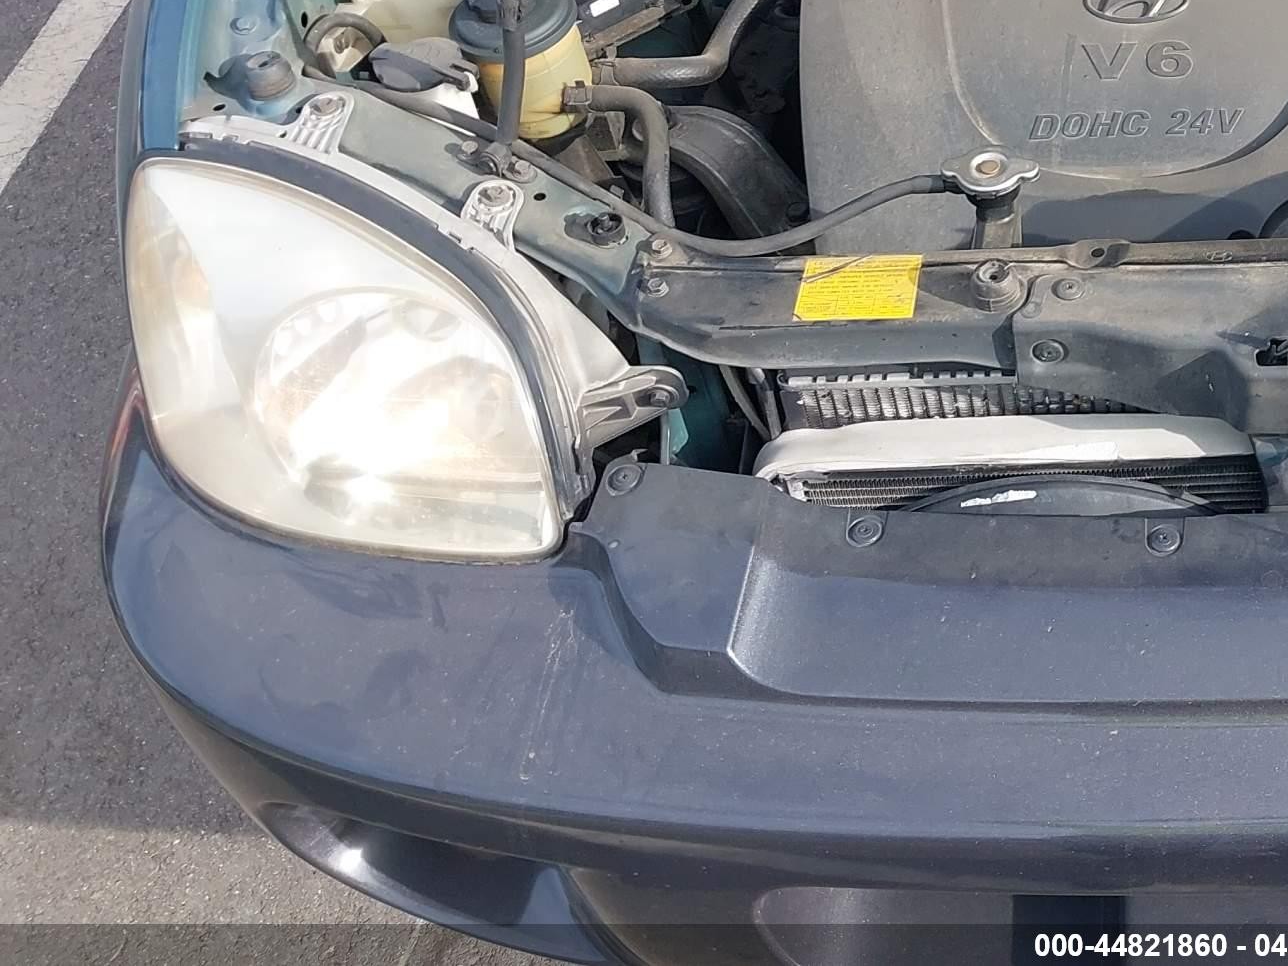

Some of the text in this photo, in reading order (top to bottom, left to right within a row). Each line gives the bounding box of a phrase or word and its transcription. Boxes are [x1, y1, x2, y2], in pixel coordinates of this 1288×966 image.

[1080, 40, 1194, 81] V6
[1028, 106, 1246, 141] DOHC 24V
